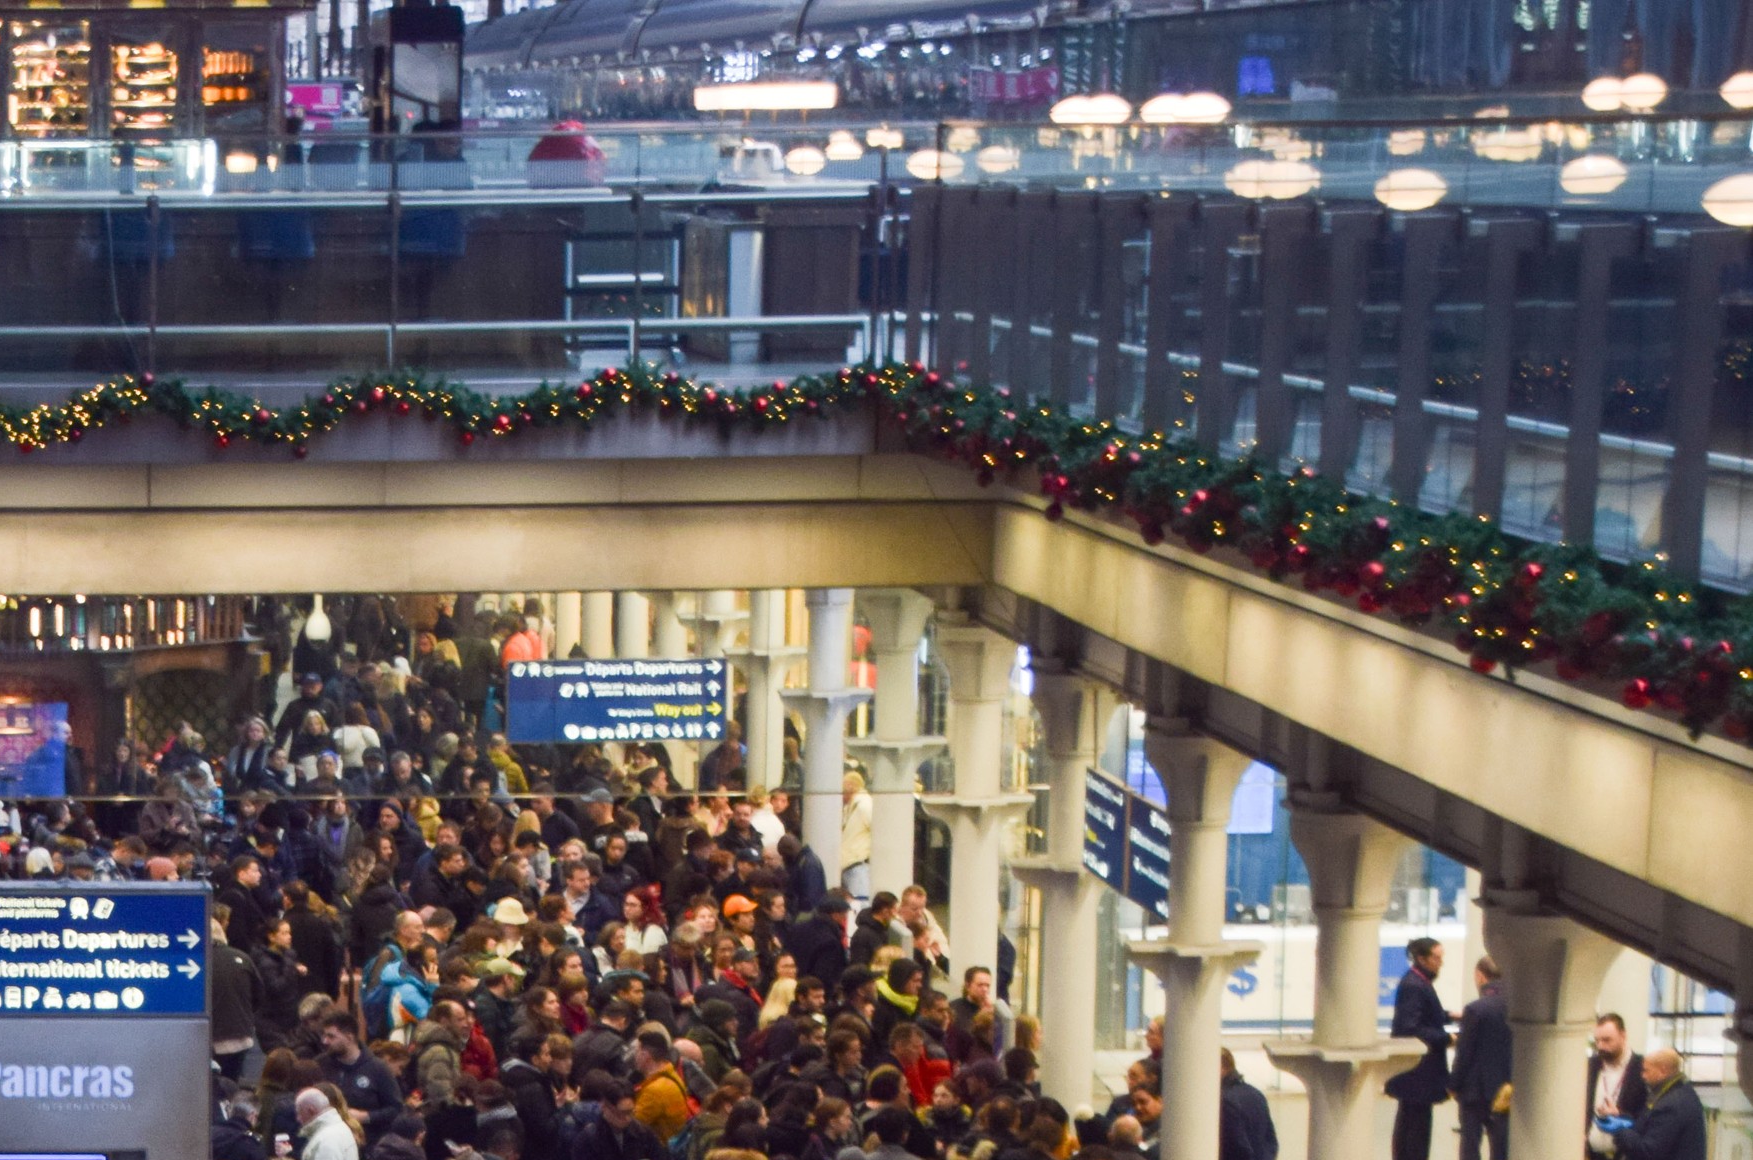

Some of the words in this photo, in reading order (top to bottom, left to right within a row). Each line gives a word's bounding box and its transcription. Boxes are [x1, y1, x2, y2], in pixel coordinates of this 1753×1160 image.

[585, 662, 633, 678] Départs
[634, 661, 703, 677] Departures
[625, 682, 676, 696] National
[677, 682, 703, 695] Rail
[653, 703, 682, 718] Way
[682, 705, 703, 716] out
[61, 928, 170, 952] Departures
[105, 958, 171, 980] tickets
